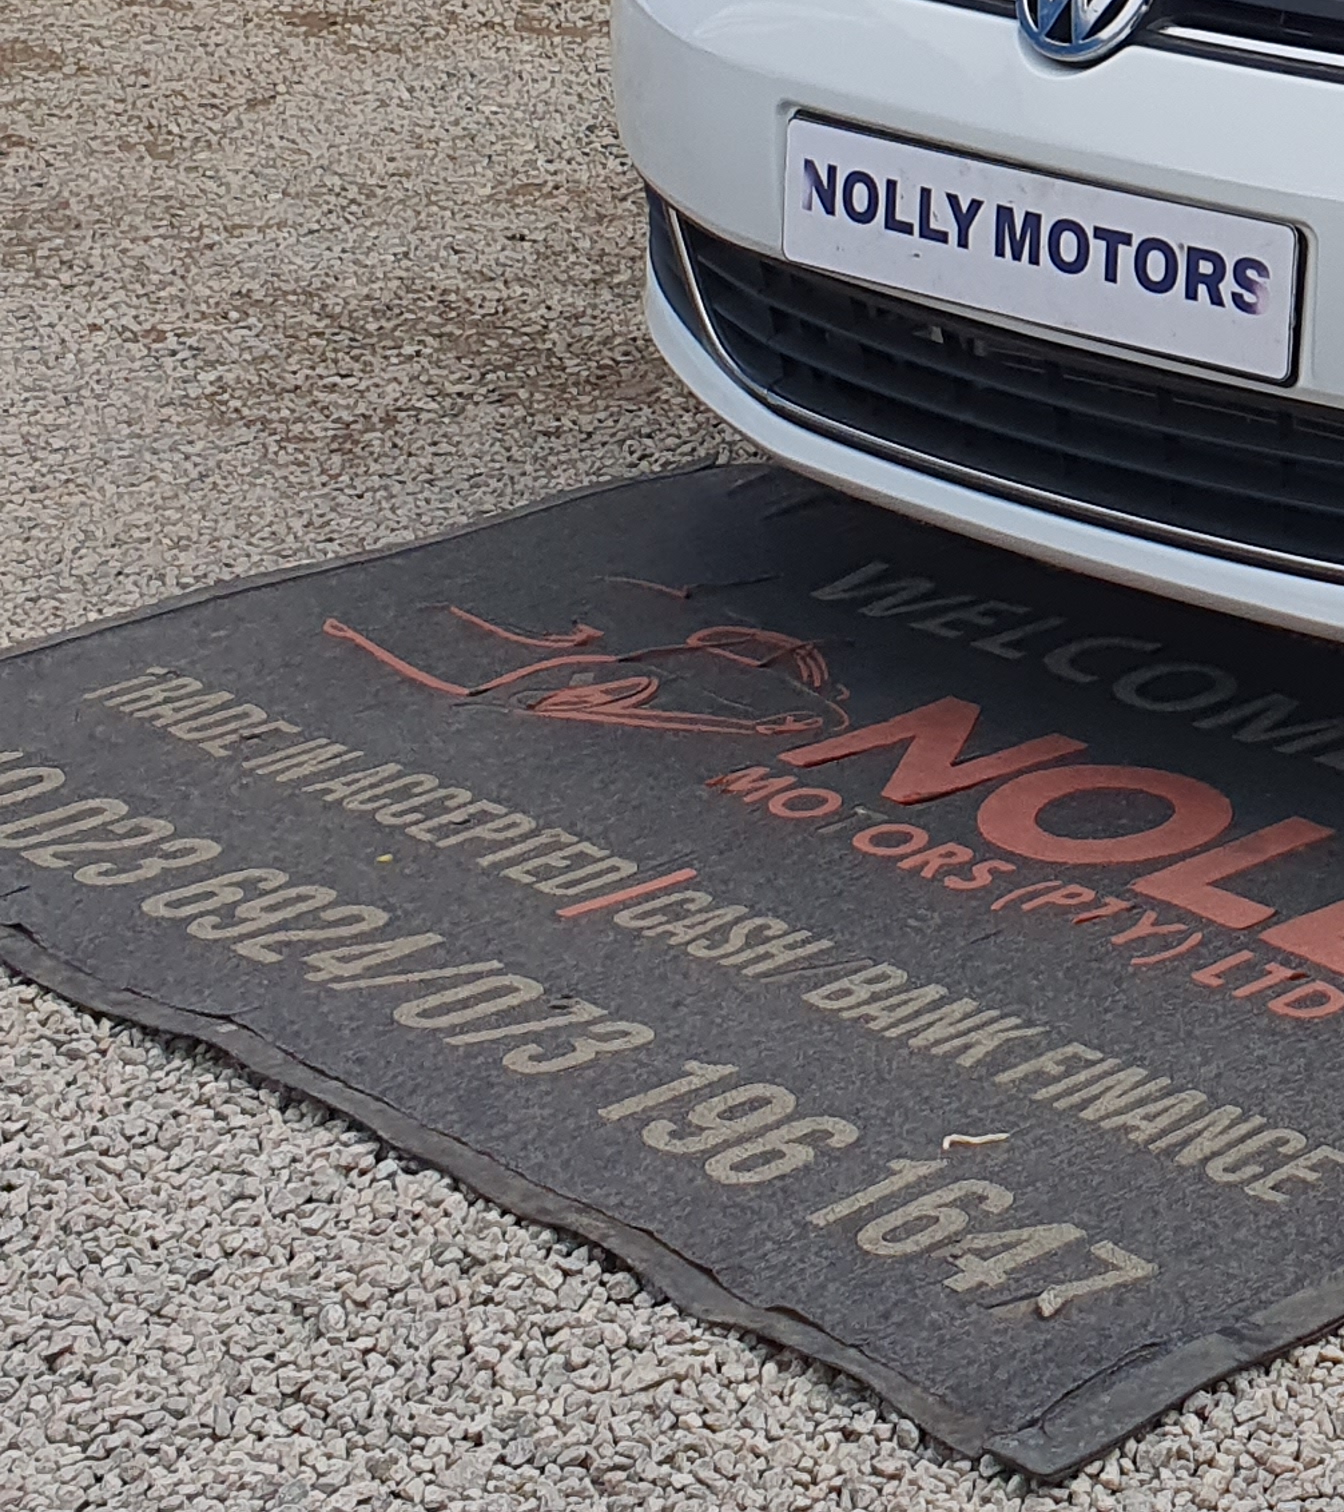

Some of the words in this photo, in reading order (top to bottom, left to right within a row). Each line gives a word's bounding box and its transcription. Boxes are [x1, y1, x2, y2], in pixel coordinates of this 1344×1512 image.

[802, 158, 984, 249] NOLLY
[994, 204, 1271, 316] MOTORS
[83, 666, 302, 758] TRADE
[241, 737, 365, 782] IN
[705, 765, 1016, 889] MOTORS
[990, 879, 1202, 966] (PTY)
[0, 798, 221, 886] 023
[141, 866, 655, 1075] 6924/073
[598, 1058, 860, 1185] 196
[808, 1156, 1160, 1318] 1647
